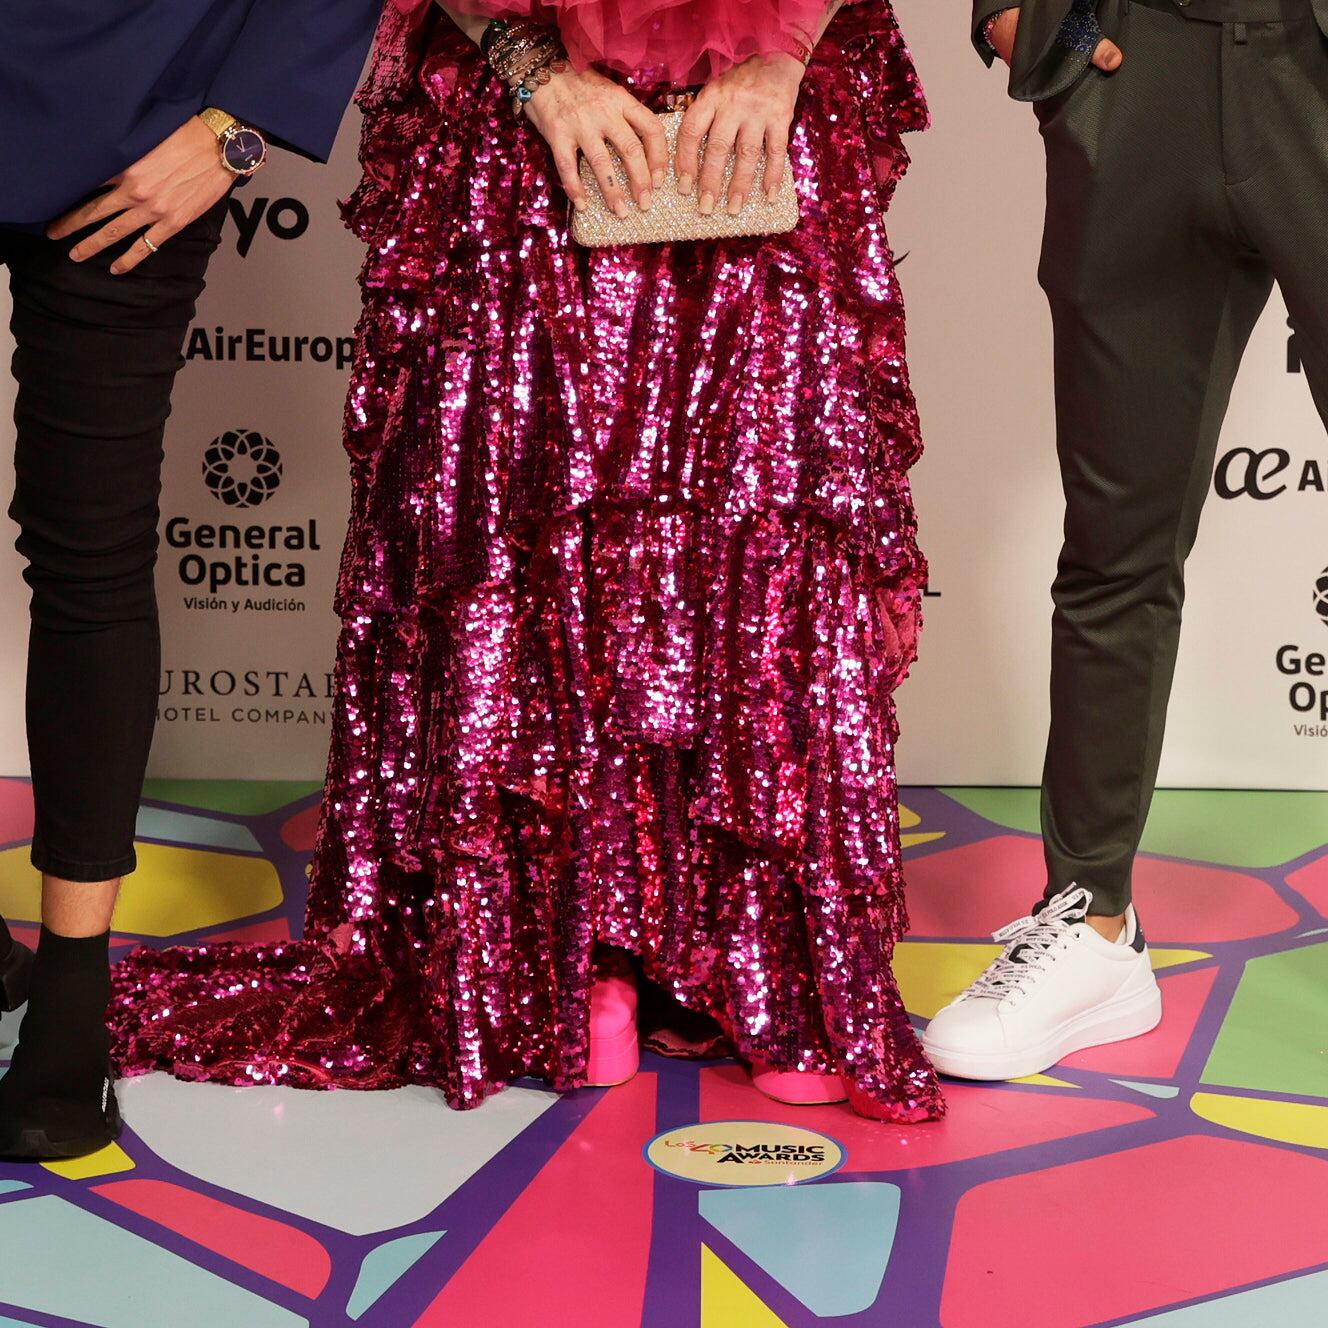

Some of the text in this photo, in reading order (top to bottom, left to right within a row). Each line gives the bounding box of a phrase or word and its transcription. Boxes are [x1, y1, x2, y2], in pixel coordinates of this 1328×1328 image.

[228, 197, 309, 258] yo
[186, 327, 355, 370] AirEurop
[165, 517, 320, 551] General
[178, 554, 305, 593] Optica
[184, 597, 305, 612] Visión y Audición
[156, 708, 333, 724] OTEL COMPAN
[717, 1152, 824, 1164] AWARDS
[736, 1144, 824, 1154] MUSIC
